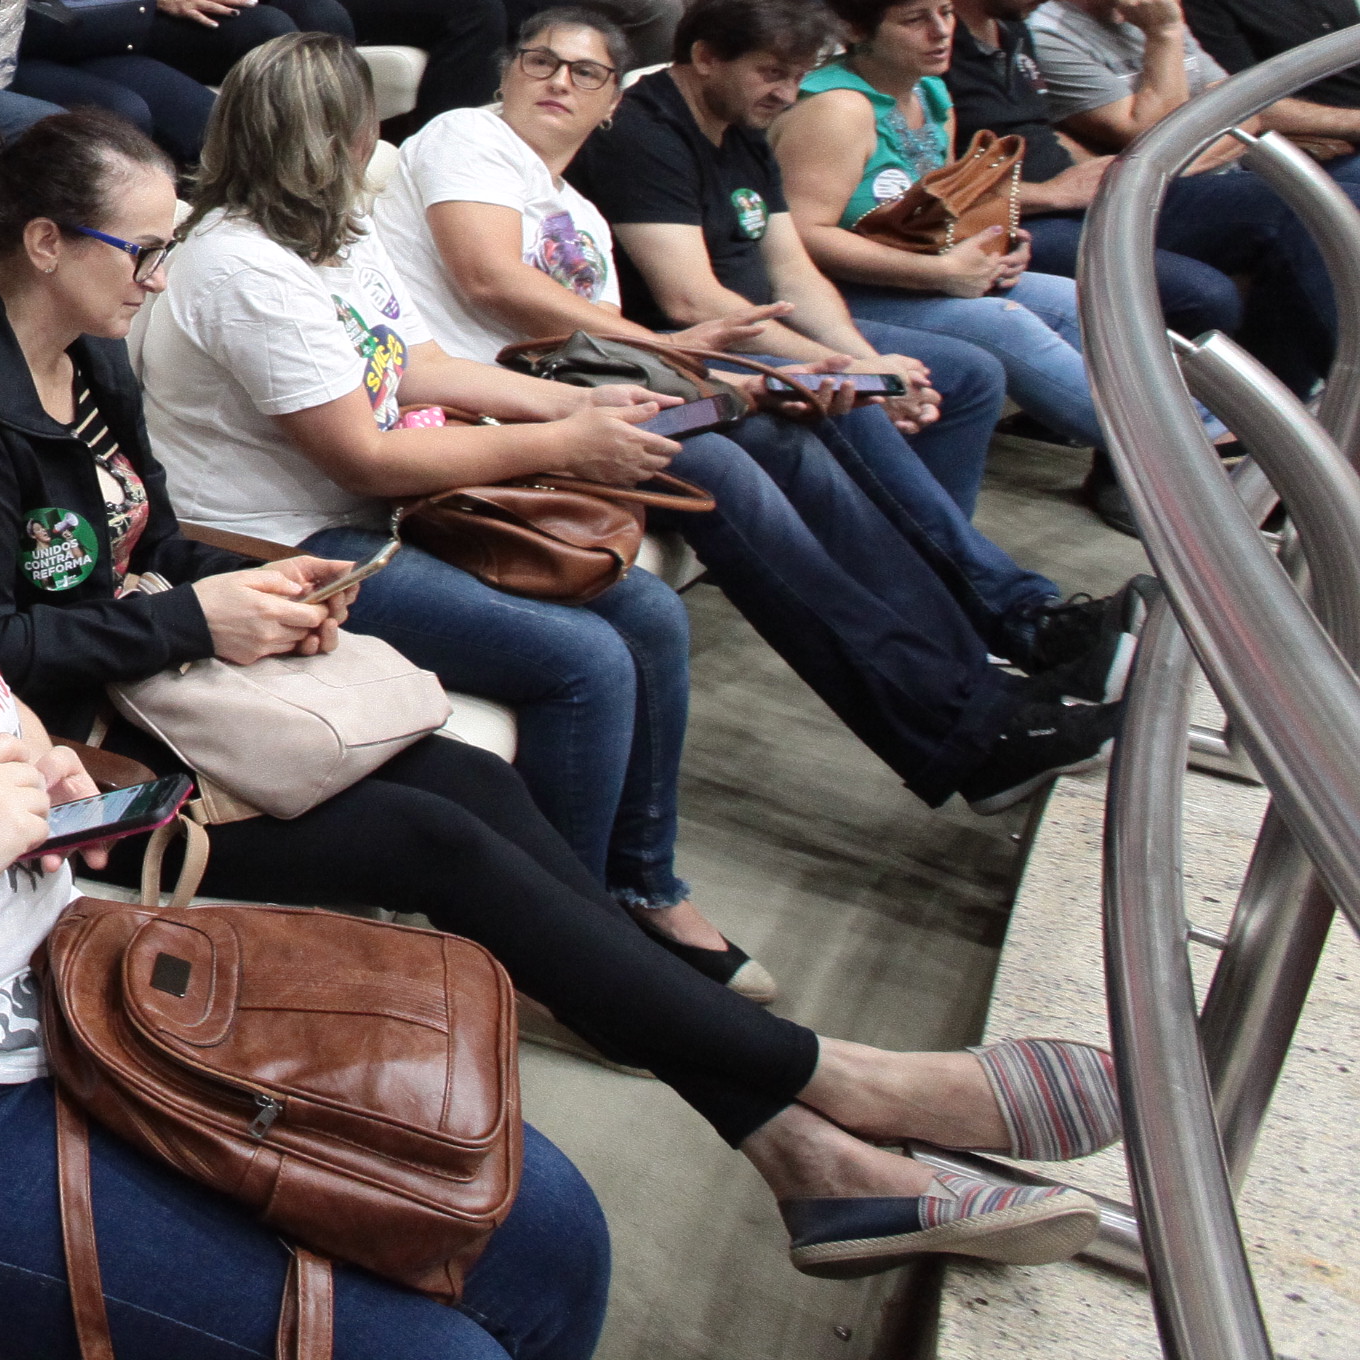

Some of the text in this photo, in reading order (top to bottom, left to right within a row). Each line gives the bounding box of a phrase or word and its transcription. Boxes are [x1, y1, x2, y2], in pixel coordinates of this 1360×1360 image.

[31, 539, 79, 560] UNIDOS
[24, 551, 75, 570] CONTRA
[32, 555, 93, 580] REFORMA
